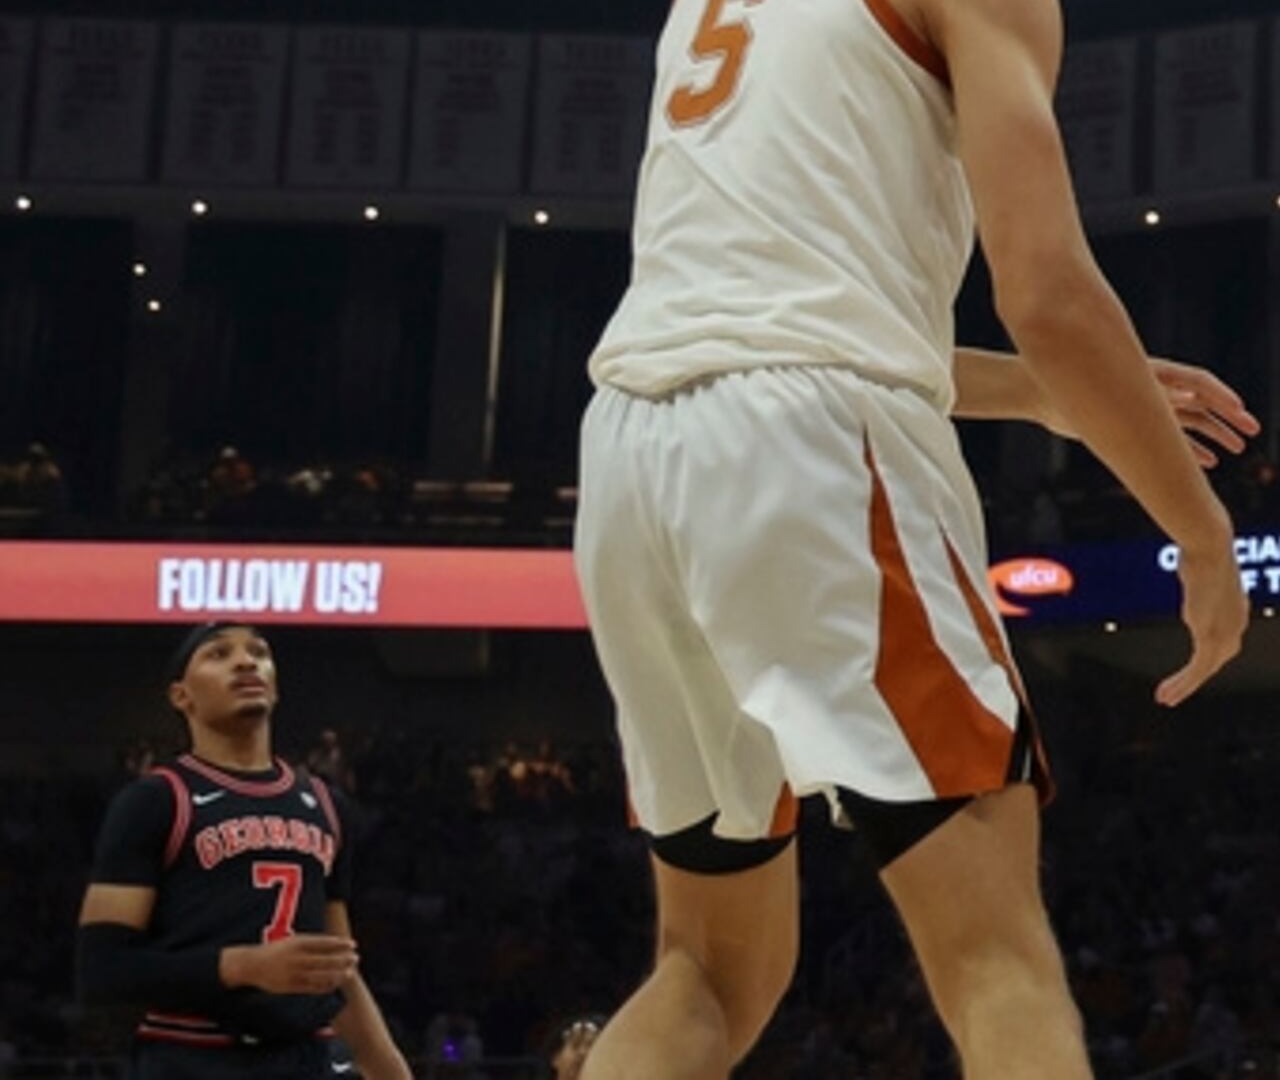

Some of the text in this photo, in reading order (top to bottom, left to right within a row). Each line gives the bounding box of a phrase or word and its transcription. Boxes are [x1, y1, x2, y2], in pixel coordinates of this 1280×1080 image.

[158, 558, 383, 613] FOLLOW US!
[251, 860, 303, 944] 7
